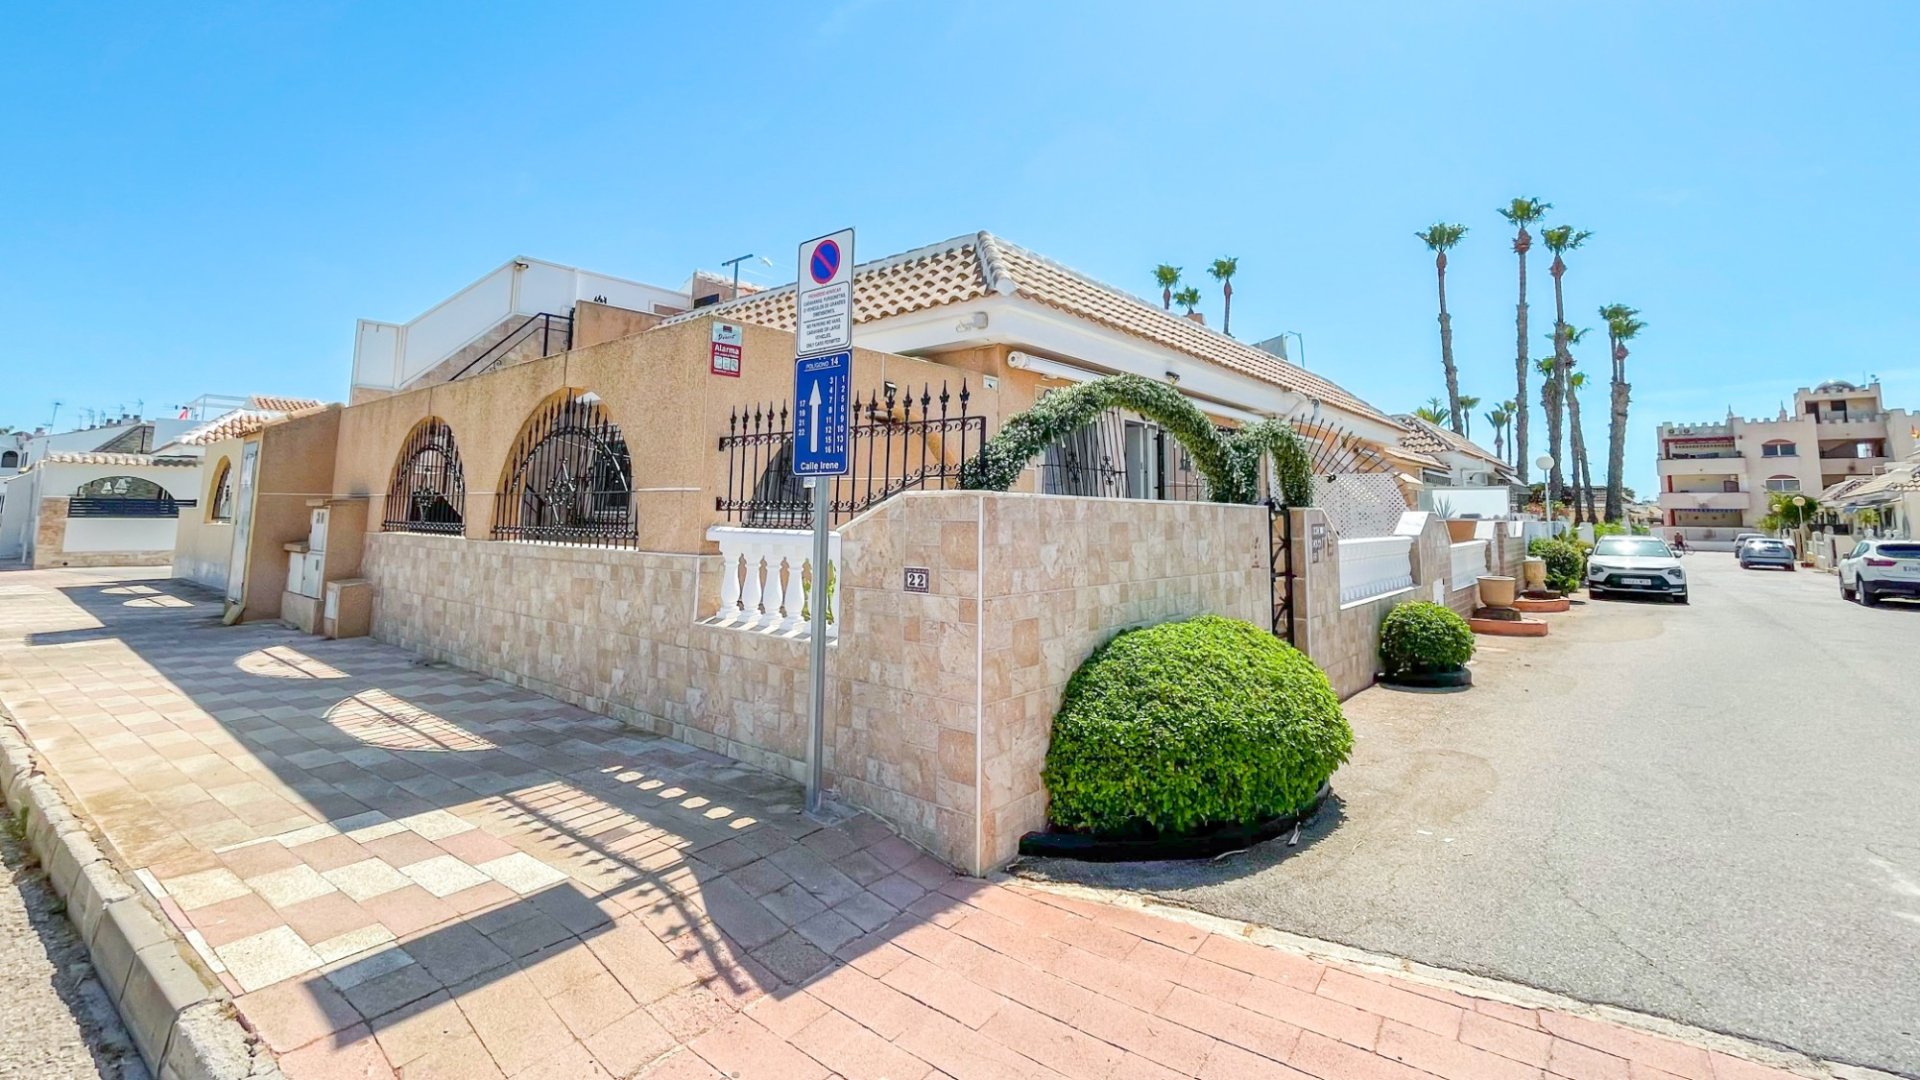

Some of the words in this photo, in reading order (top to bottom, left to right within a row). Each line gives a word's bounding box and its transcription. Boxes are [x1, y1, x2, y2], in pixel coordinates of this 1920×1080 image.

[715, 344, 739, 355] Alarma
[830, 356, 839, 365] 14
[829, 376, 833, 384] 3
[841, 394, 845, 403] 5
[840, 405, 844, 413] 6
[840, 415, 844, 423] 9
[837, 425, 844, 433] 10
[837, 435, 844, 443] 13
[800, 461, 818, 470] Calle
[820, 461, 839, 469] Irene
[909, 573, 924, 586] 22
